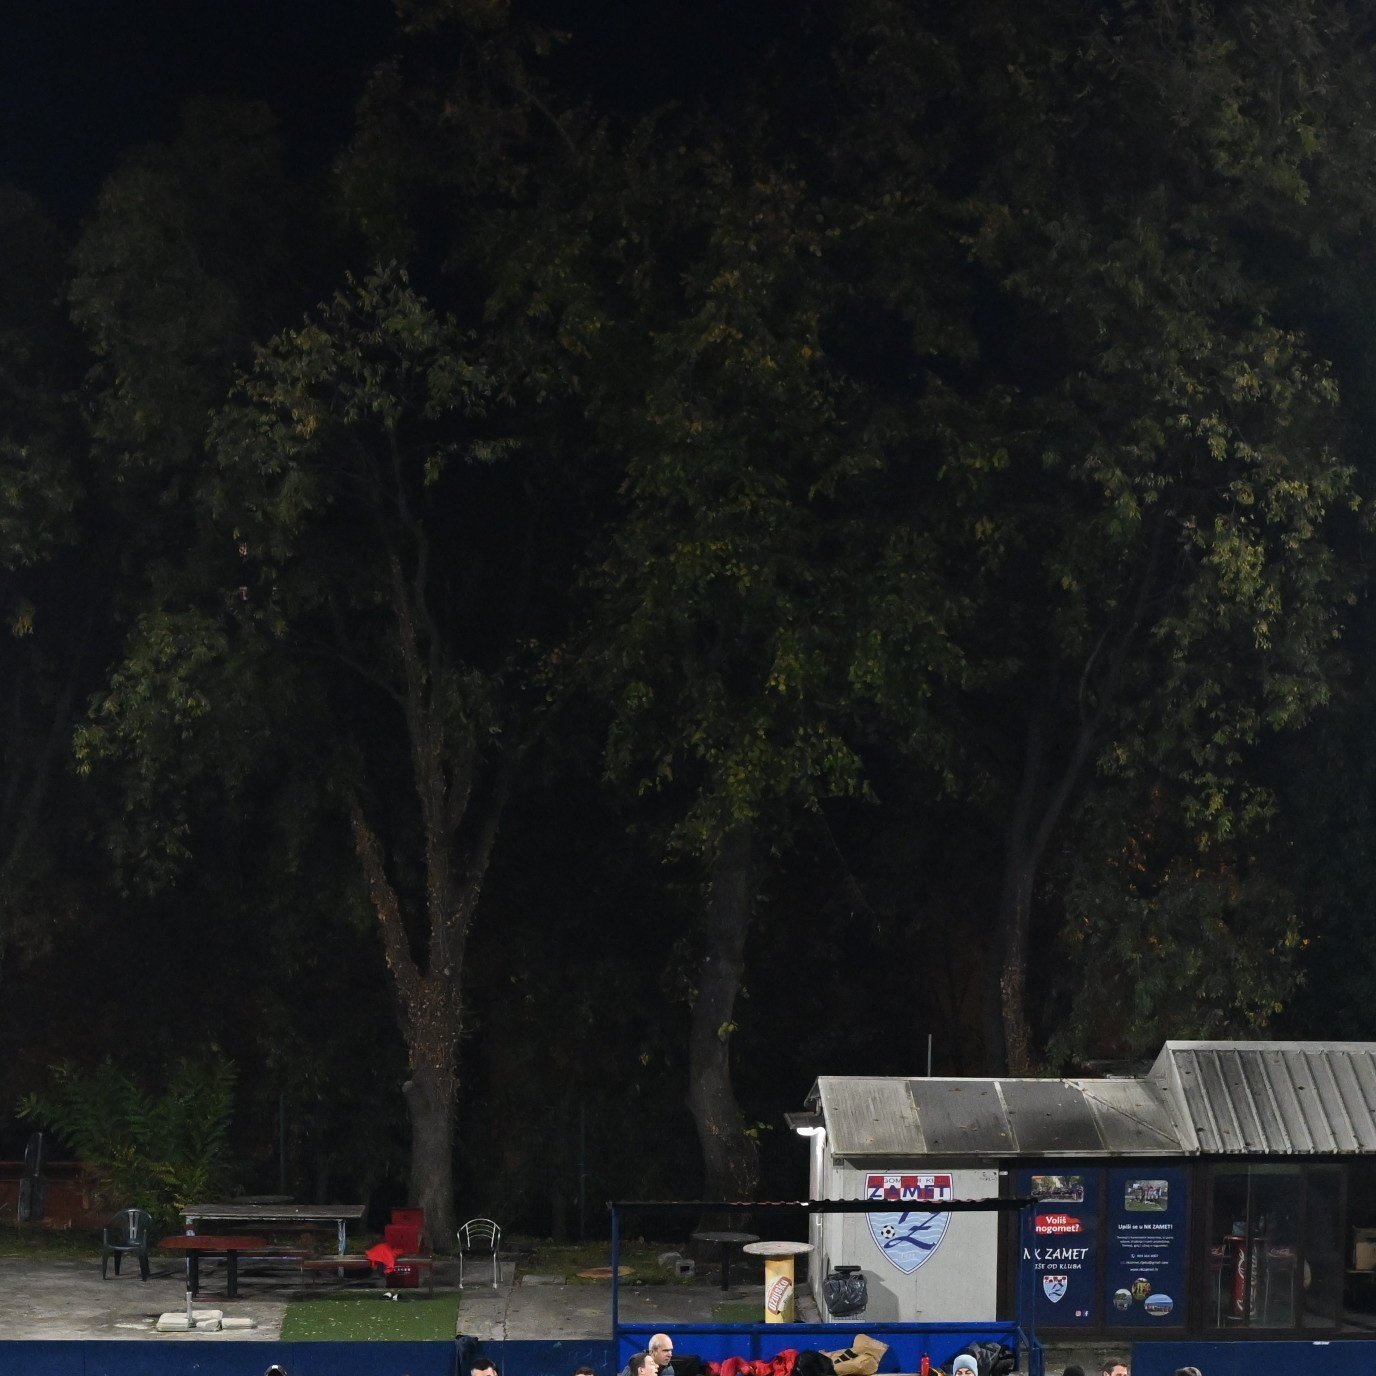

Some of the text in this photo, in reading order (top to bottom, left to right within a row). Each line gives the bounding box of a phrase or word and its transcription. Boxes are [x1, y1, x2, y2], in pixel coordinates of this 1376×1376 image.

[869, 1184, 945, 1198] ZAMET
[1045, 1215, 1067, 1225] Voliš
[1035, 1223, 1080, 1235] nogomet?
[1044, 1247, 1089, 1260] ZAMET
